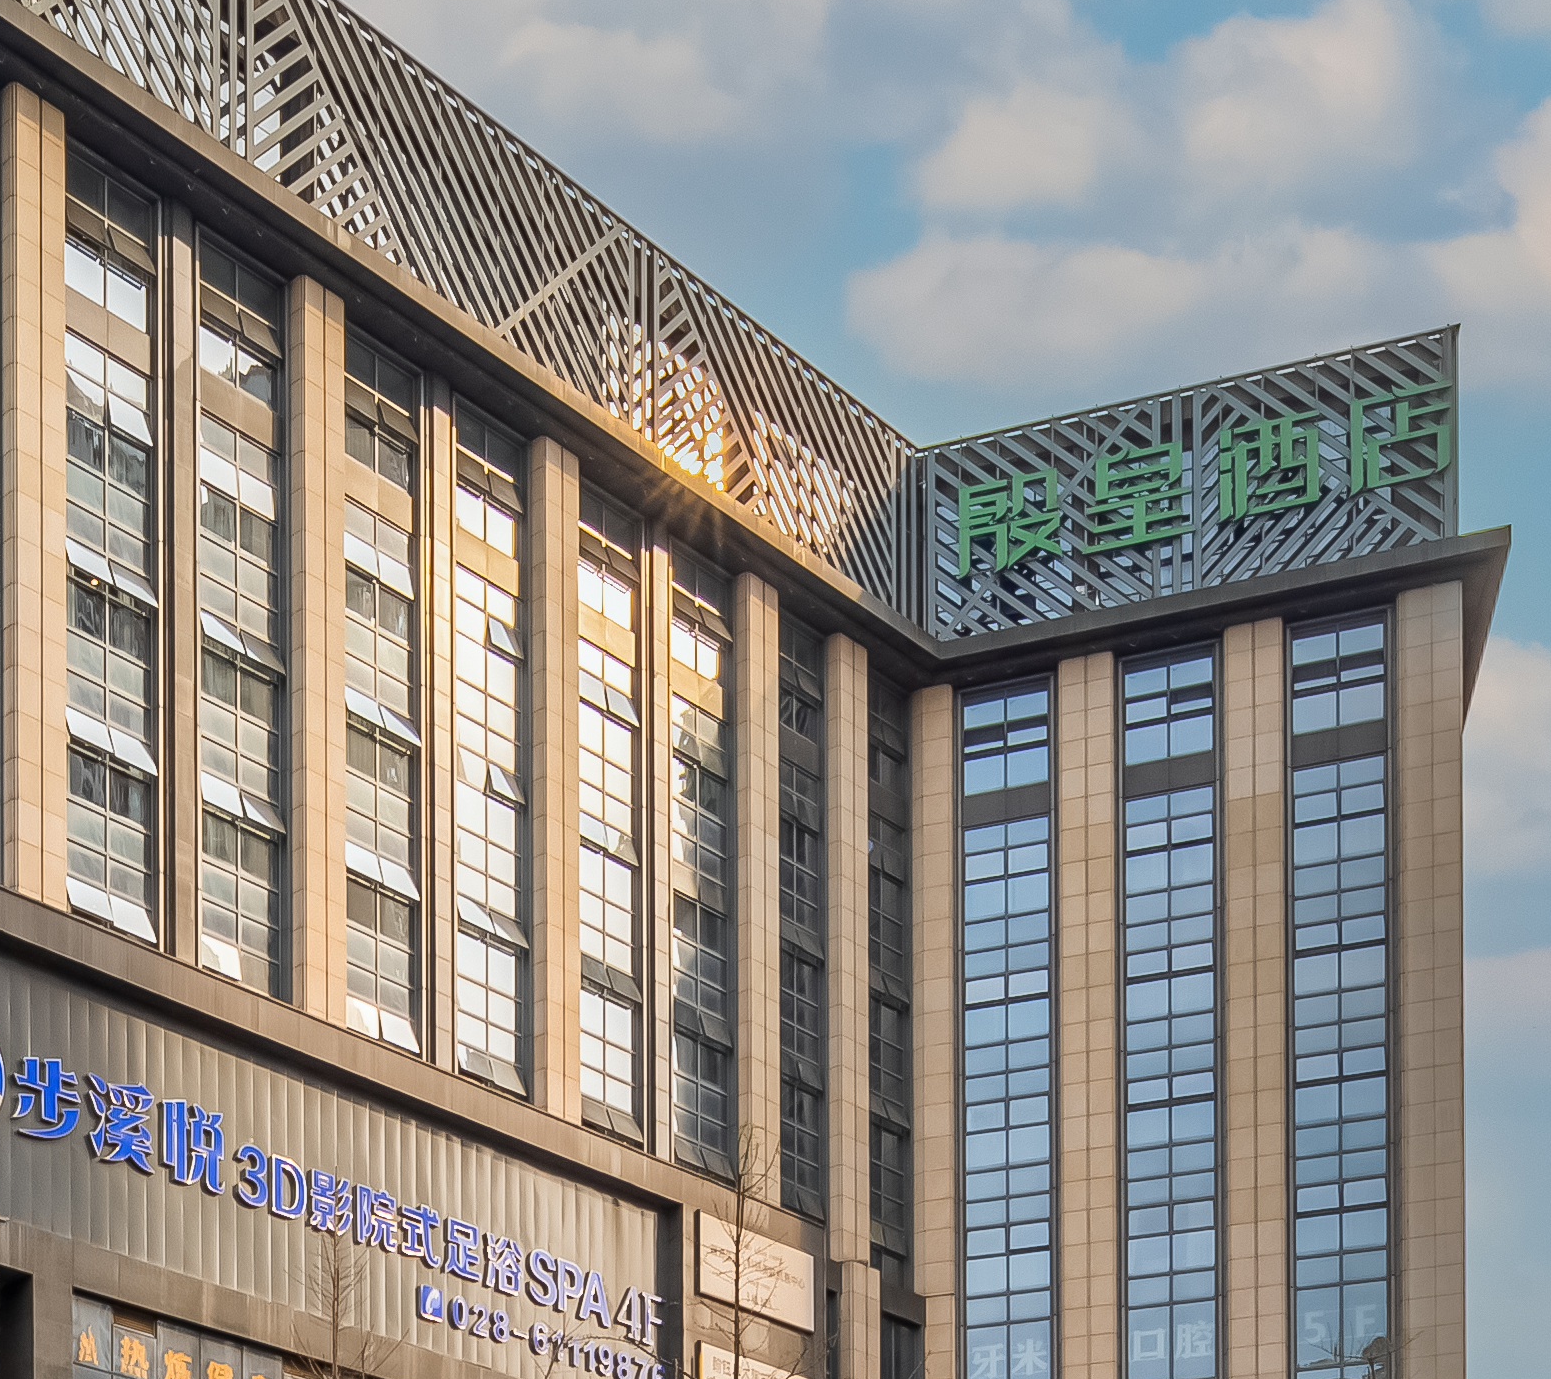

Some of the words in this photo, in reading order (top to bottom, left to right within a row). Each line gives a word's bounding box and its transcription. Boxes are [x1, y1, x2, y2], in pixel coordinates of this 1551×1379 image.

[959, 381, 1452, 579] 殷皇酒店
[12, 1056, 226, 1195] 步溪悦
[616, 1286, 667, 1346] 4F
